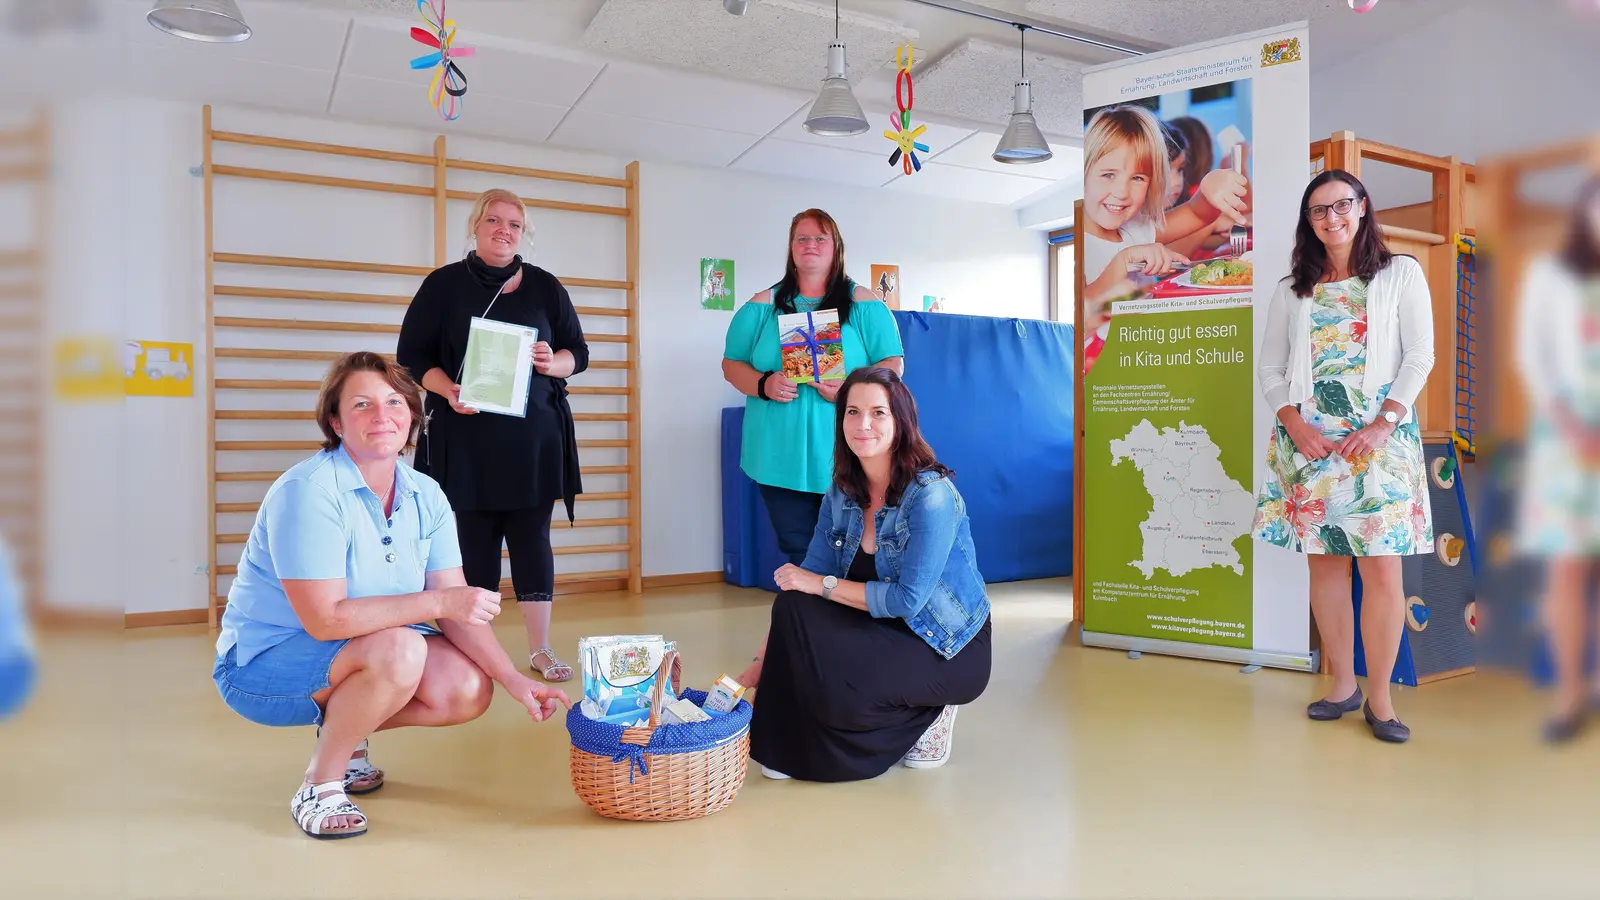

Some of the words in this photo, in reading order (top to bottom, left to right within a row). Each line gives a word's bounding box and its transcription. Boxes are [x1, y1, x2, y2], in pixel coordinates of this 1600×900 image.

[1176, 58, 1239, 75] Staatsministerium
[1158, 71, 1208, 86] Landwirtschaft
[1225, 64, 1252, 73] Forsten
[1118, 301, 1170, 311] Vernetzungsstelle
[1198, 297, 1252, 305] Schulverpflegung
[1120, 325, 1164, 344] Richtig
[1169, 325, 1191, 343] gut
[1196, 324, 1237, 338] essen
[1120, 352, 1131, 367] in
[1136, 351, 1161, 366] Kita
[1166, 349, 1191, 366] und
[1196, 347, 1244, 364] Schule
[1153, 585, 1199, 595] Schulverpflegung
[1147, 614, 1245, 629] www.schulverpflegung.bayern.de
[1151, 623, 1245, 638] www.kitaverpflegung.bayern.de
